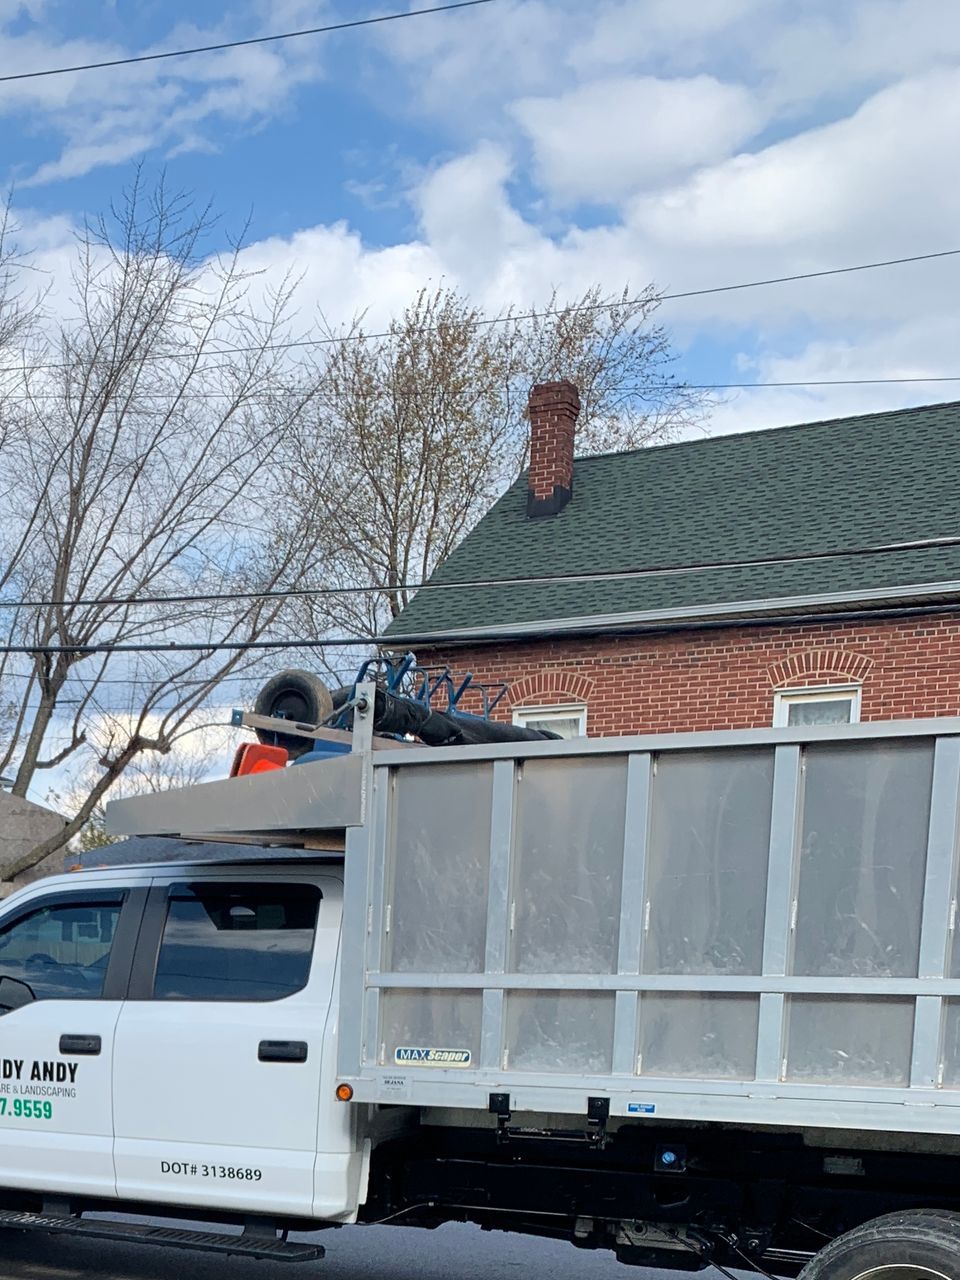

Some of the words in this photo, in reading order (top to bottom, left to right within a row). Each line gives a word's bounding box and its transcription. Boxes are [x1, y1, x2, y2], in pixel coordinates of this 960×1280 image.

[30, 1060, 79, 1083] ANDY
[12, 1085, 19, 1094] &
[20, 1085, 77, 1098] LANDSCAPING
[160, 1161, 197, 1176] DOT#
[201, 1164, 262, 1181] 3138689
